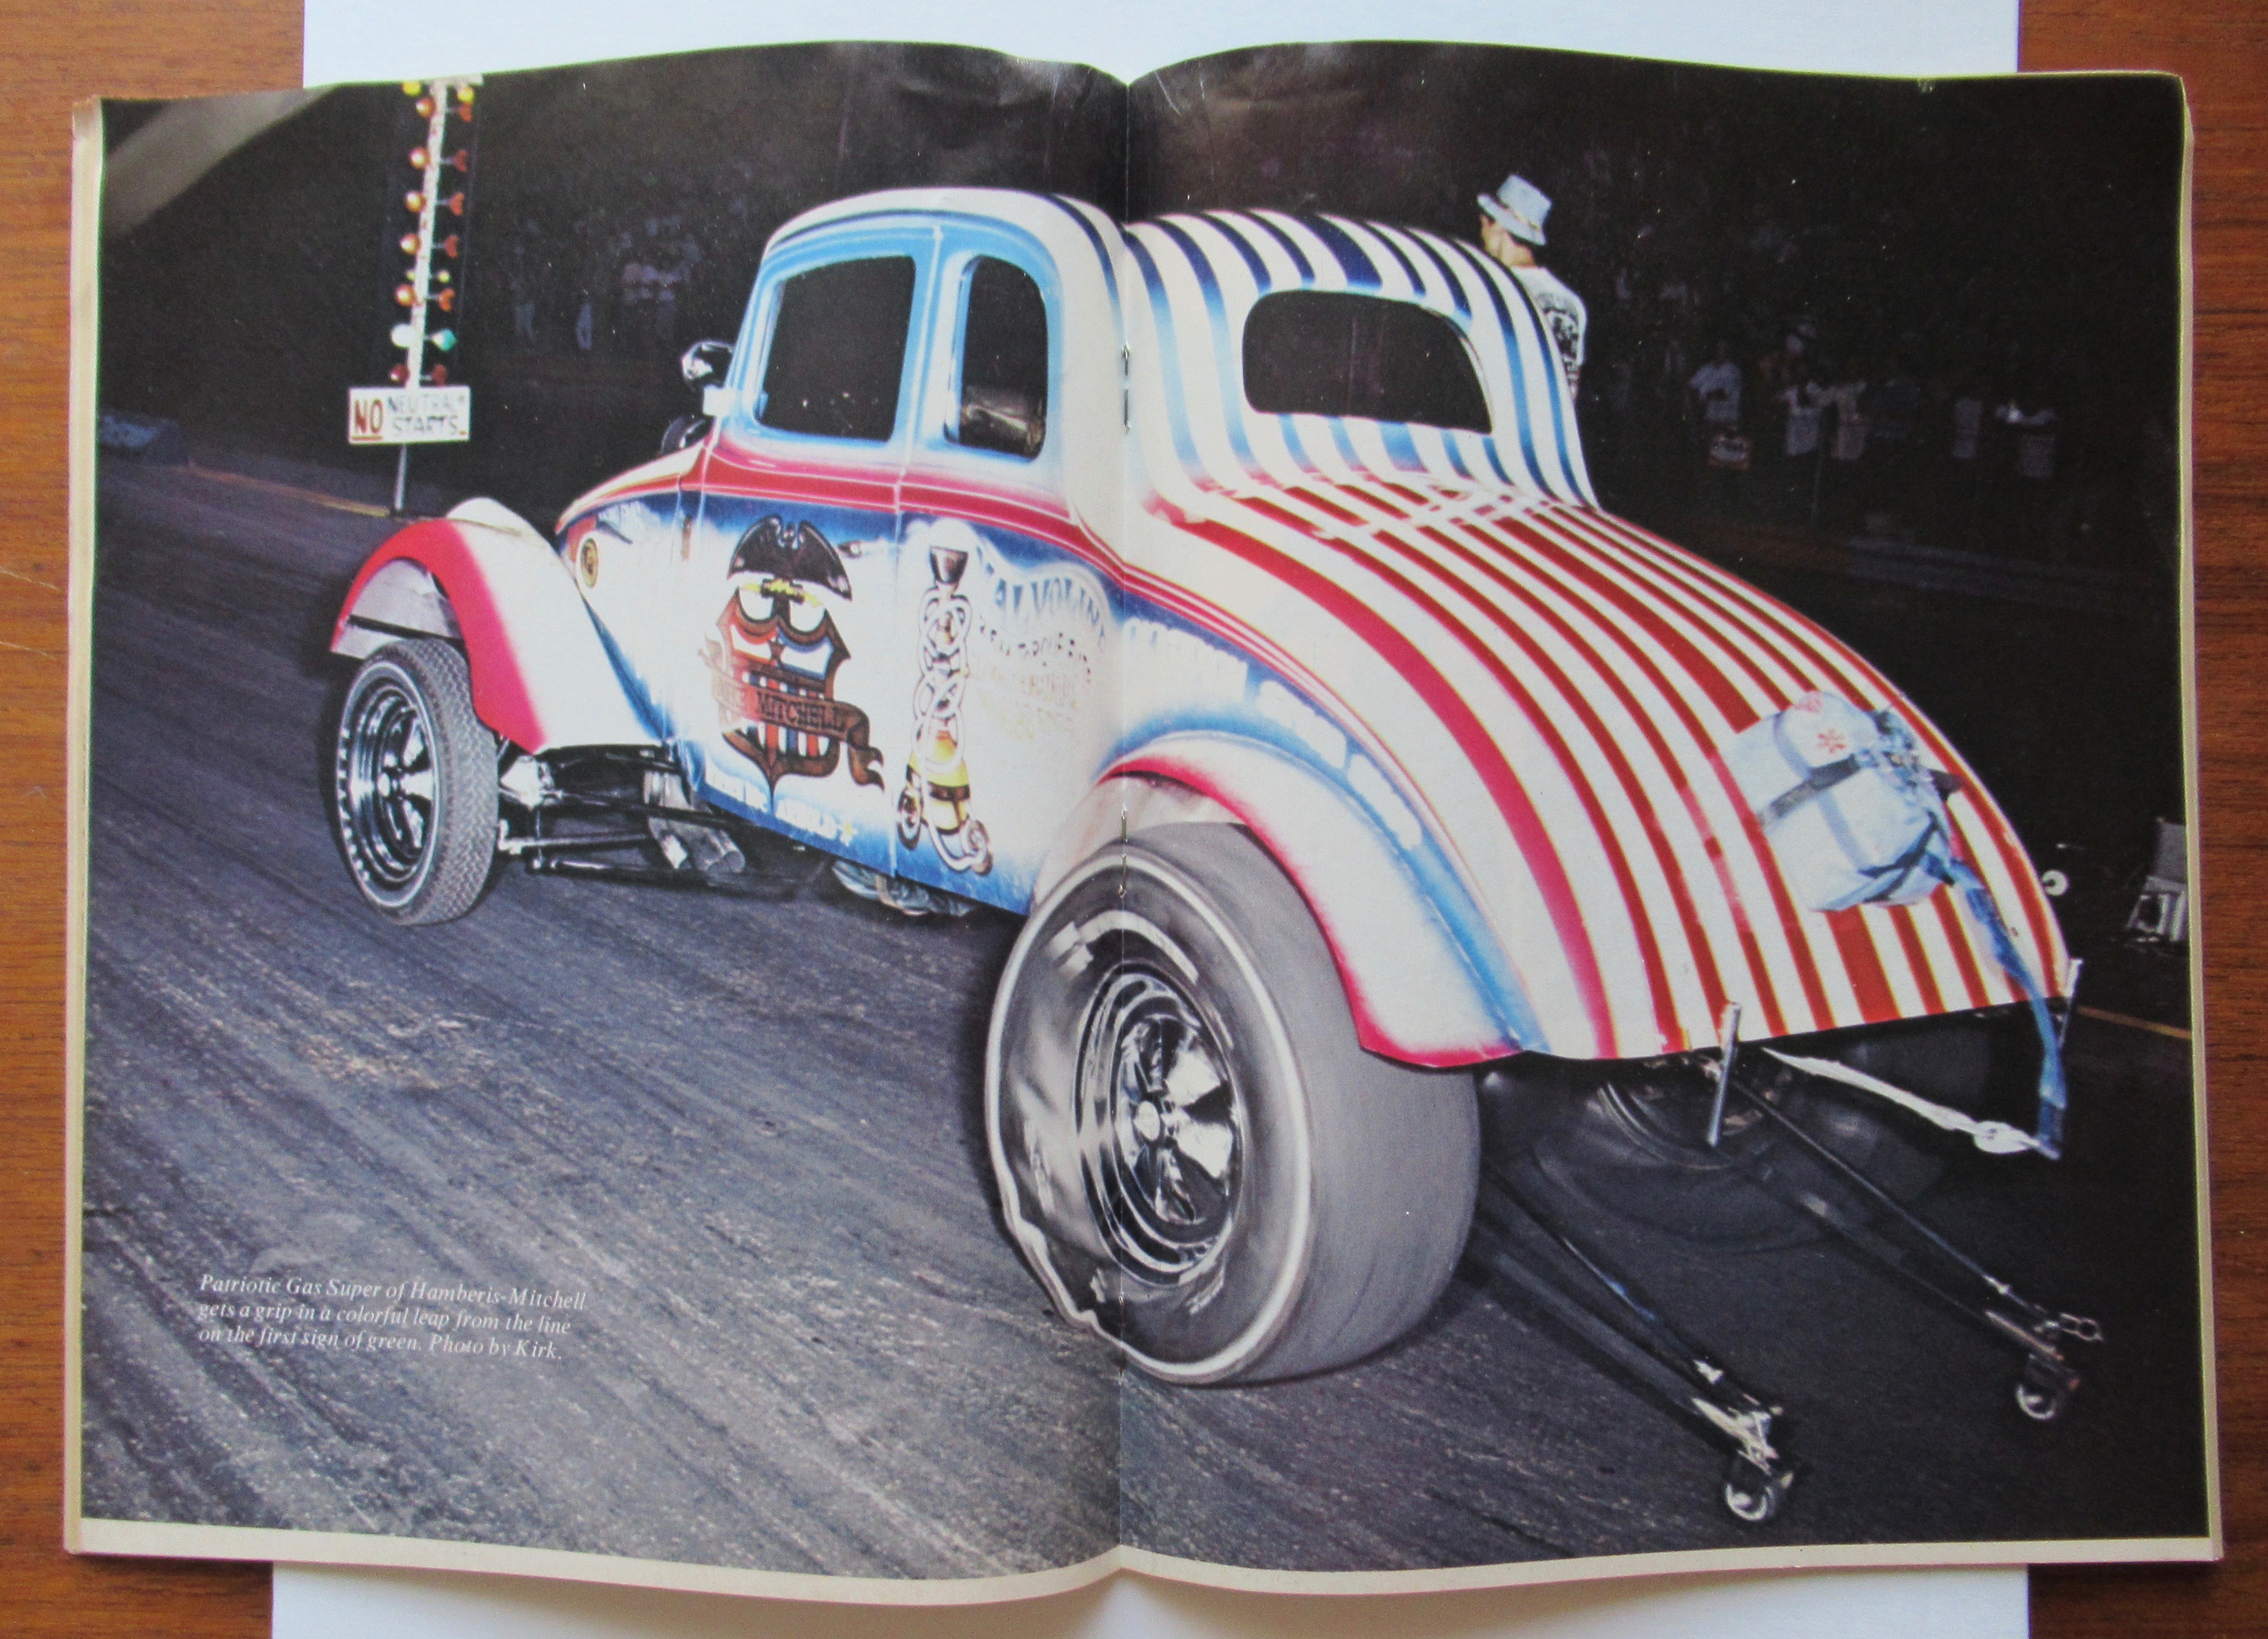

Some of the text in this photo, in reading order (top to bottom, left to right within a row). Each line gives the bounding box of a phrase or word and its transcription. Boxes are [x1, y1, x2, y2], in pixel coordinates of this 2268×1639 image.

[354, 397, 384, 434] NO
[200, 1273, 281, 1293] Patriotic
[286, 1277, 322, 1295] Gas
[326, 1279, 382, 1300] Super
[386, 1281, 409, 1301] of
[199, 1302, 571, 1335] gets a grip in a colorful leap from the line
[199, 1328, 221, 1342] on
[227, 1325, 255, 1343] the
[255, 1326, 298, 1348] first
[302, 1329, 340, 1350] sign
[345, 1330, 367, 1351] of
[429, 1332, 484, 1354] Photo
[489, 1336, 512, 1357] by
[515, 1338, 563, 1360] Kirk.
